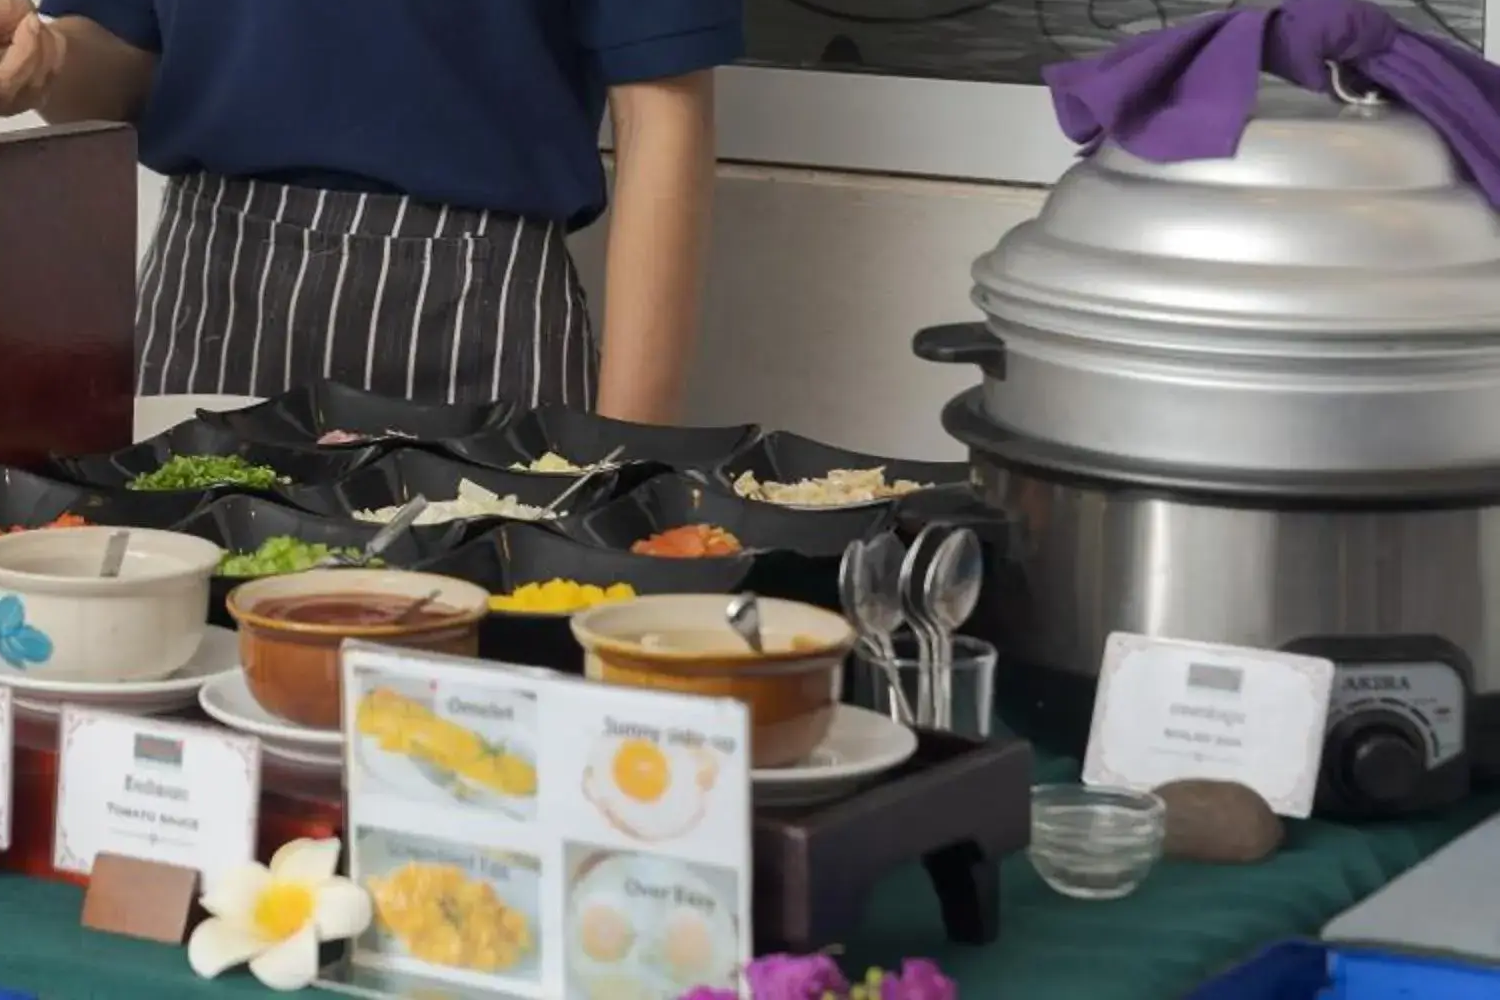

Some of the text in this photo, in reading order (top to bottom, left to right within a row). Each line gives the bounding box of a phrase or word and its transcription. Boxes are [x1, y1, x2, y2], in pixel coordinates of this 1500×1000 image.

[603, 715, 661, 744] Sunny
[106, 801, 156, 822] TOMATO
[624, 875, 669, 901] Over
